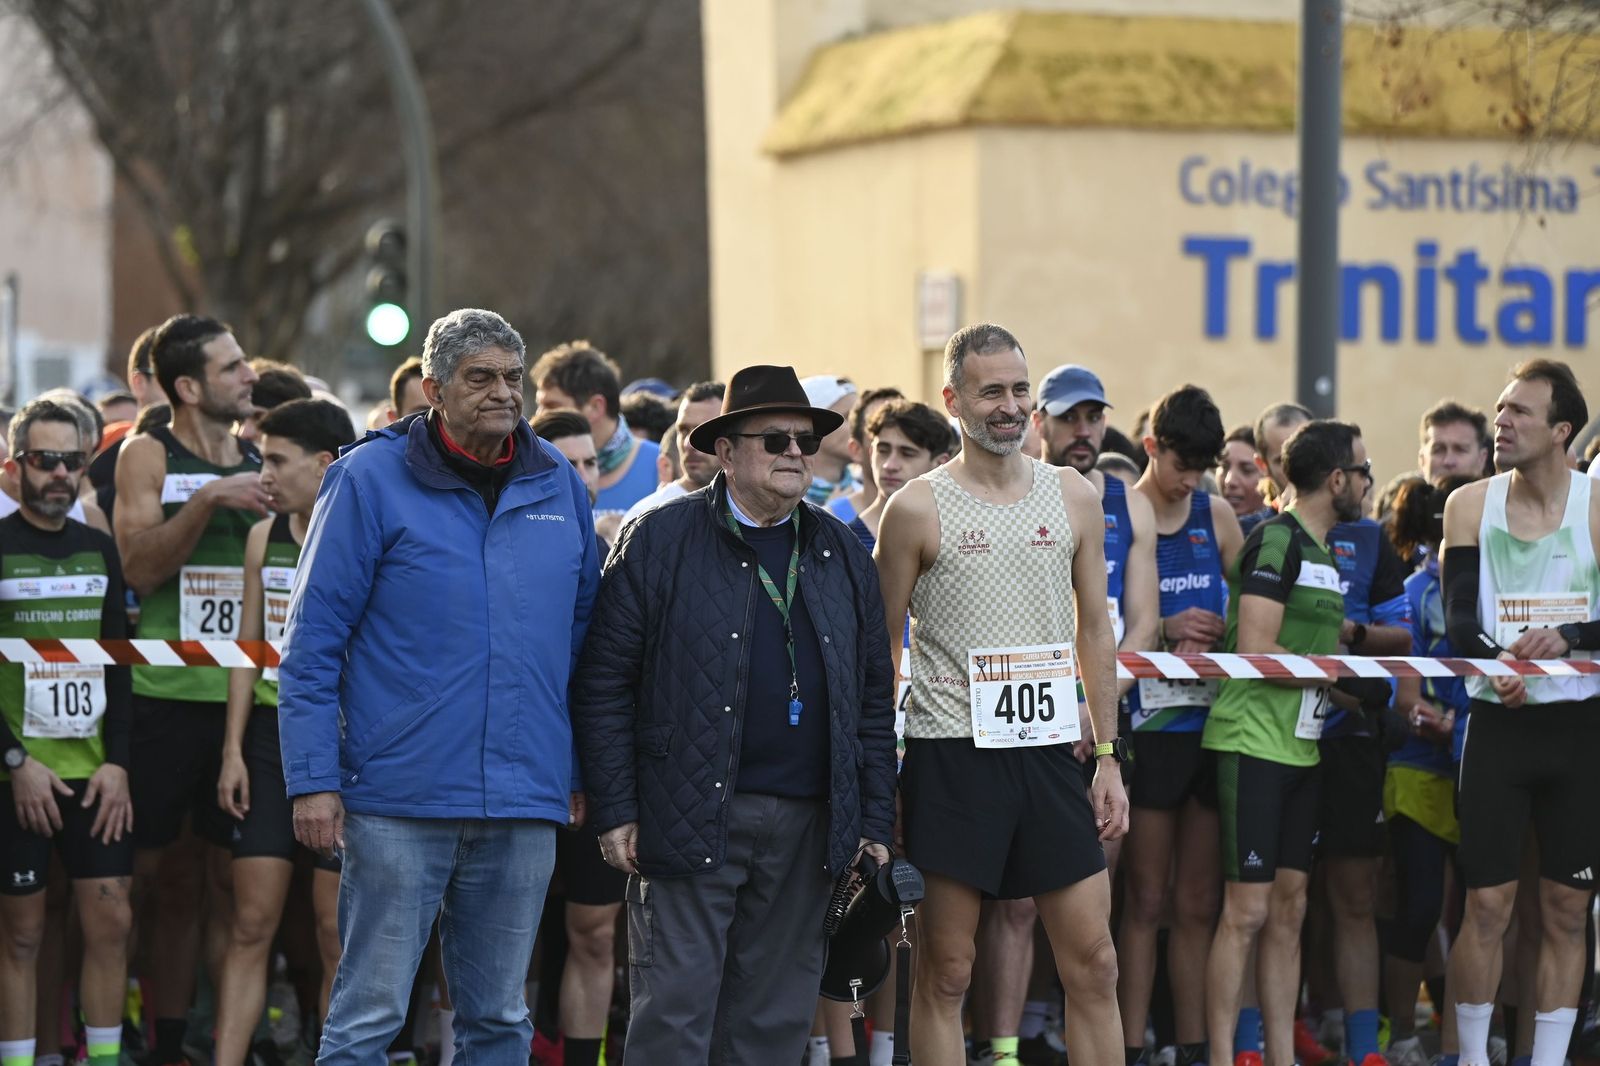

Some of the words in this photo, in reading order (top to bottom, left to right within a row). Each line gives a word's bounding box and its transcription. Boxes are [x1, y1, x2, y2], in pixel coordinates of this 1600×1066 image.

[1179, 154, 1350, 219] Coleg
[1364, 160, 1579, 214] Santísima
[1182, 235, 1600, 348] Trnitar
[184, 573, 216, 595] XLII
[14, 610, 64, 622] ATLETISMO
[201, 600, 243, 633] 28
[1500, 600, 1530, 621] XLII
[48, 683, 92, 717] 103
[994, 681, 1056, 724] 405
